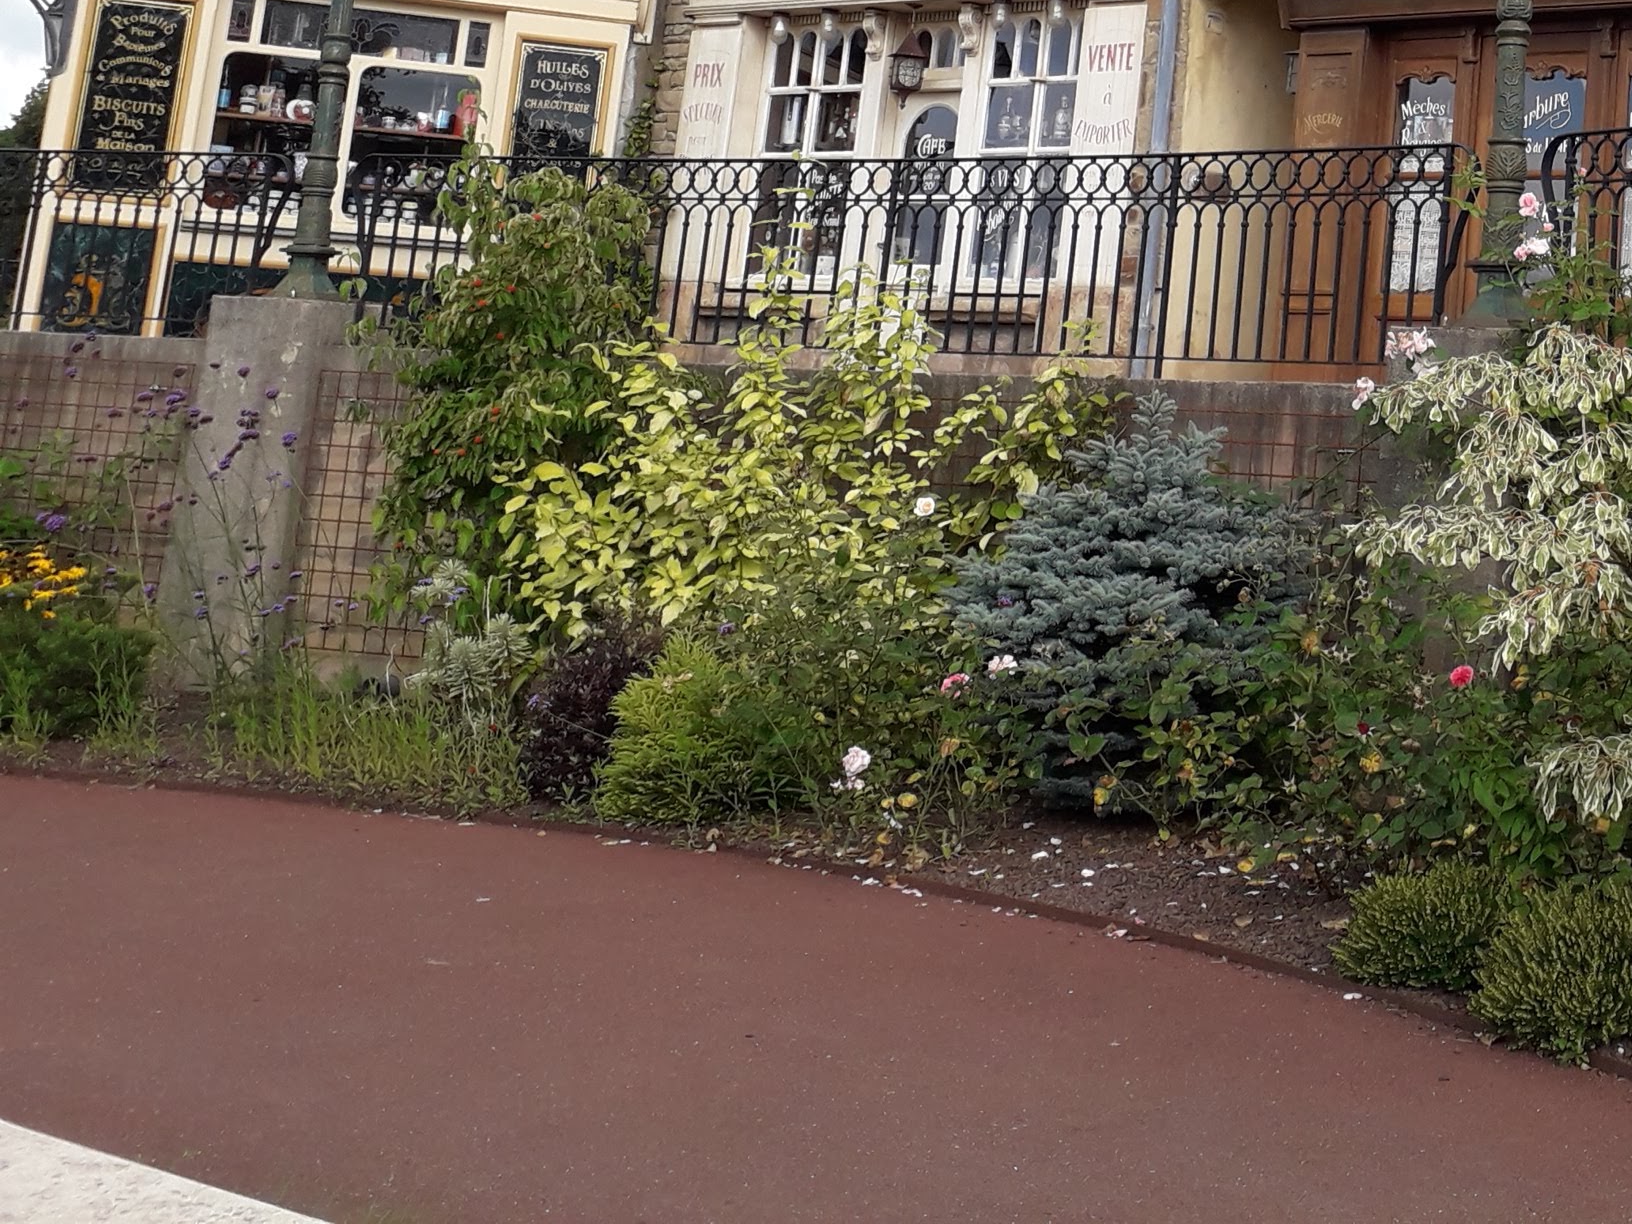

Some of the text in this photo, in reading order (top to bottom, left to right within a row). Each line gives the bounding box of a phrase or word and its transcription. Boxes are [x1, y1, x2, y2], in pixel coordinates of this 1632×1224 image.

[110, 11, 178, 36] Produits
[1088, 43, 1136, 73] VENTE
[693, 62, 725, 88] PRIX
[524, 98, 590, 114] CHARCUTERIE
[1401, 96, 1447, 121] Mèches
